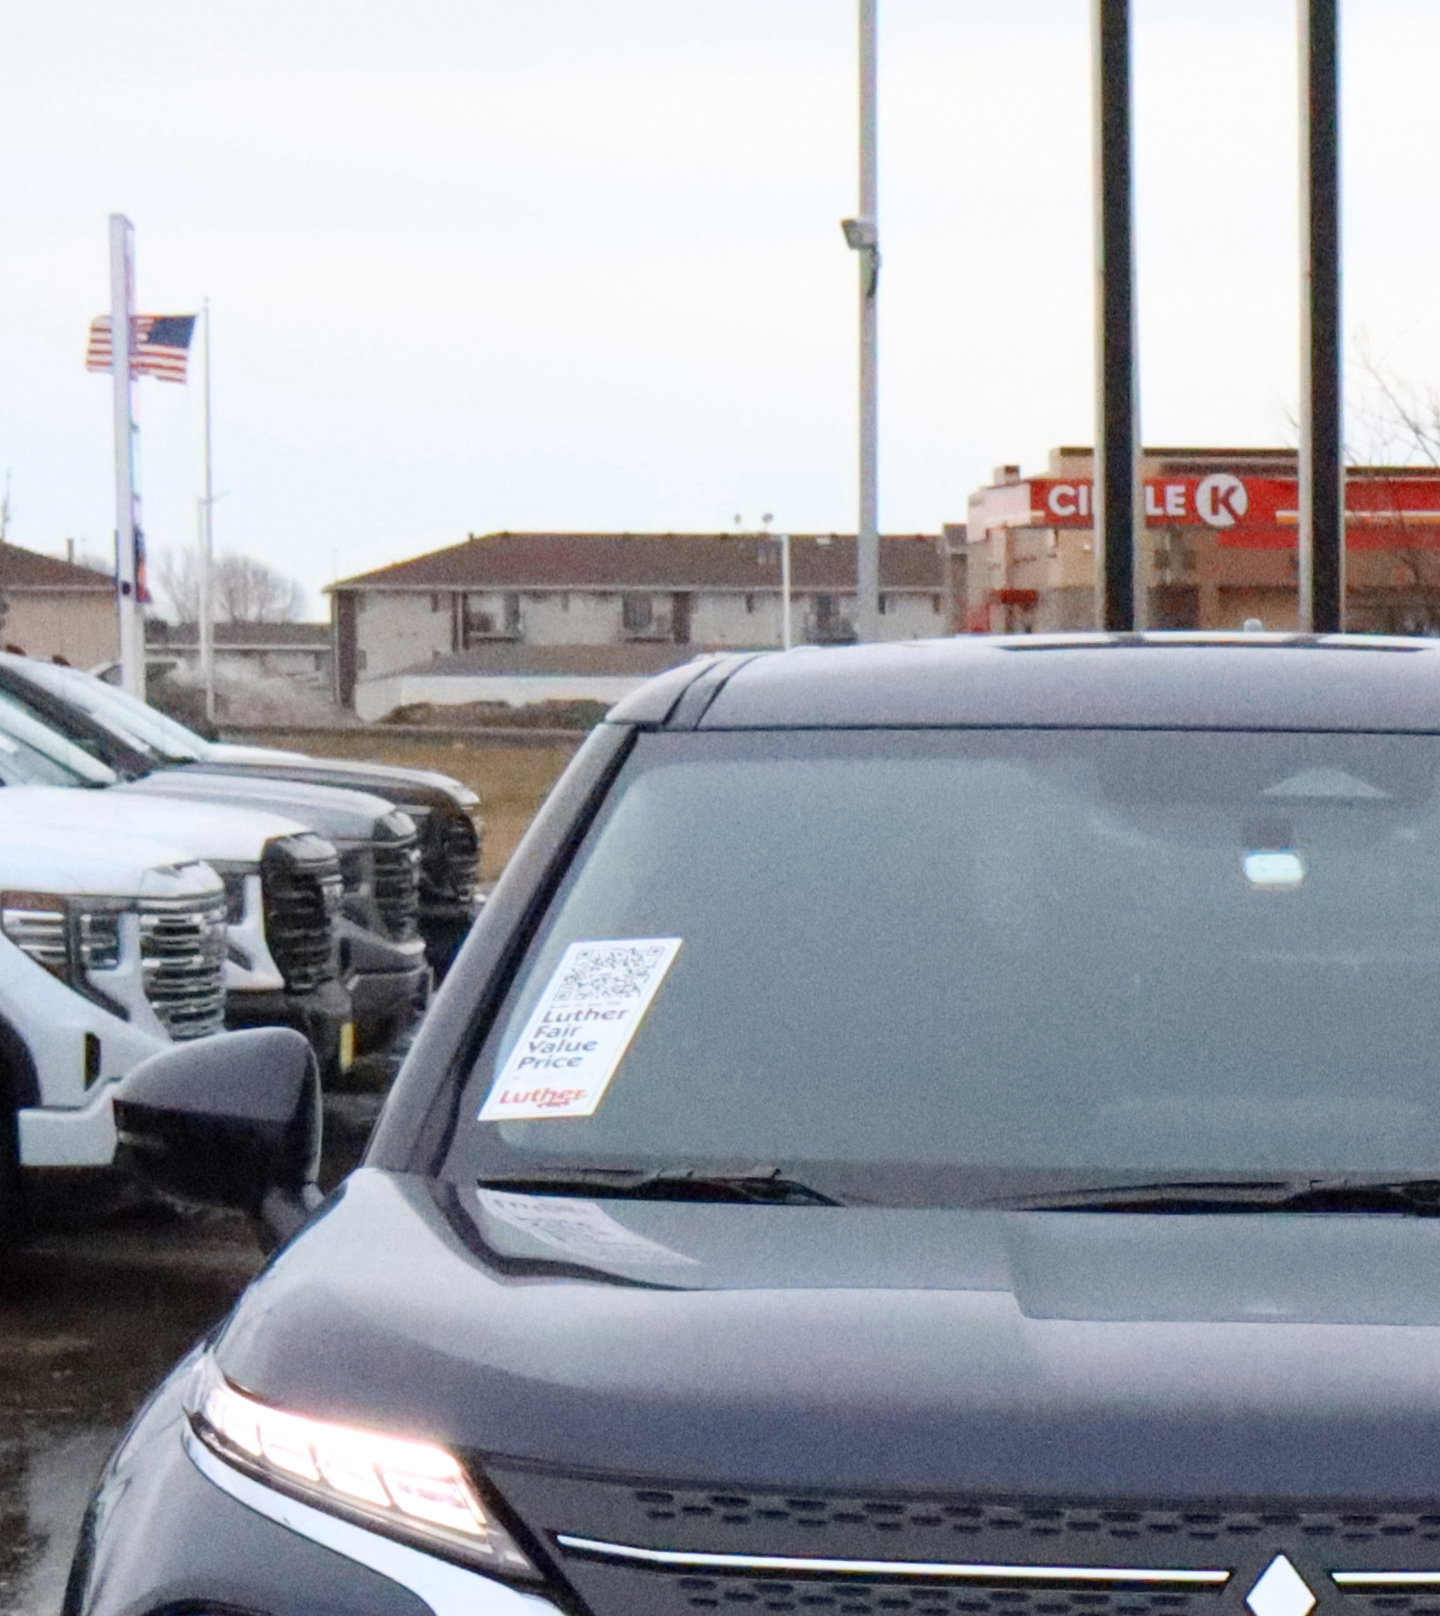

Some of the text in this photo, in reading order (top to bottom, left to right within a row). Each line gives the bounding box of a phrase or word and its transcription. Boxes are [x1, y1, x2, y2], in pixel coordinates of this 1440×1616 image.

[1048, 484, 1188, 517] CILE
[542, 1007, 630, 1024] Luther
[533, 1022, 583, 1039] Fair
[528, 1039, 599, 1054] Value
[517, 1054, 584, 1070] Price
[499, 1087, 586, 1105] Luther
